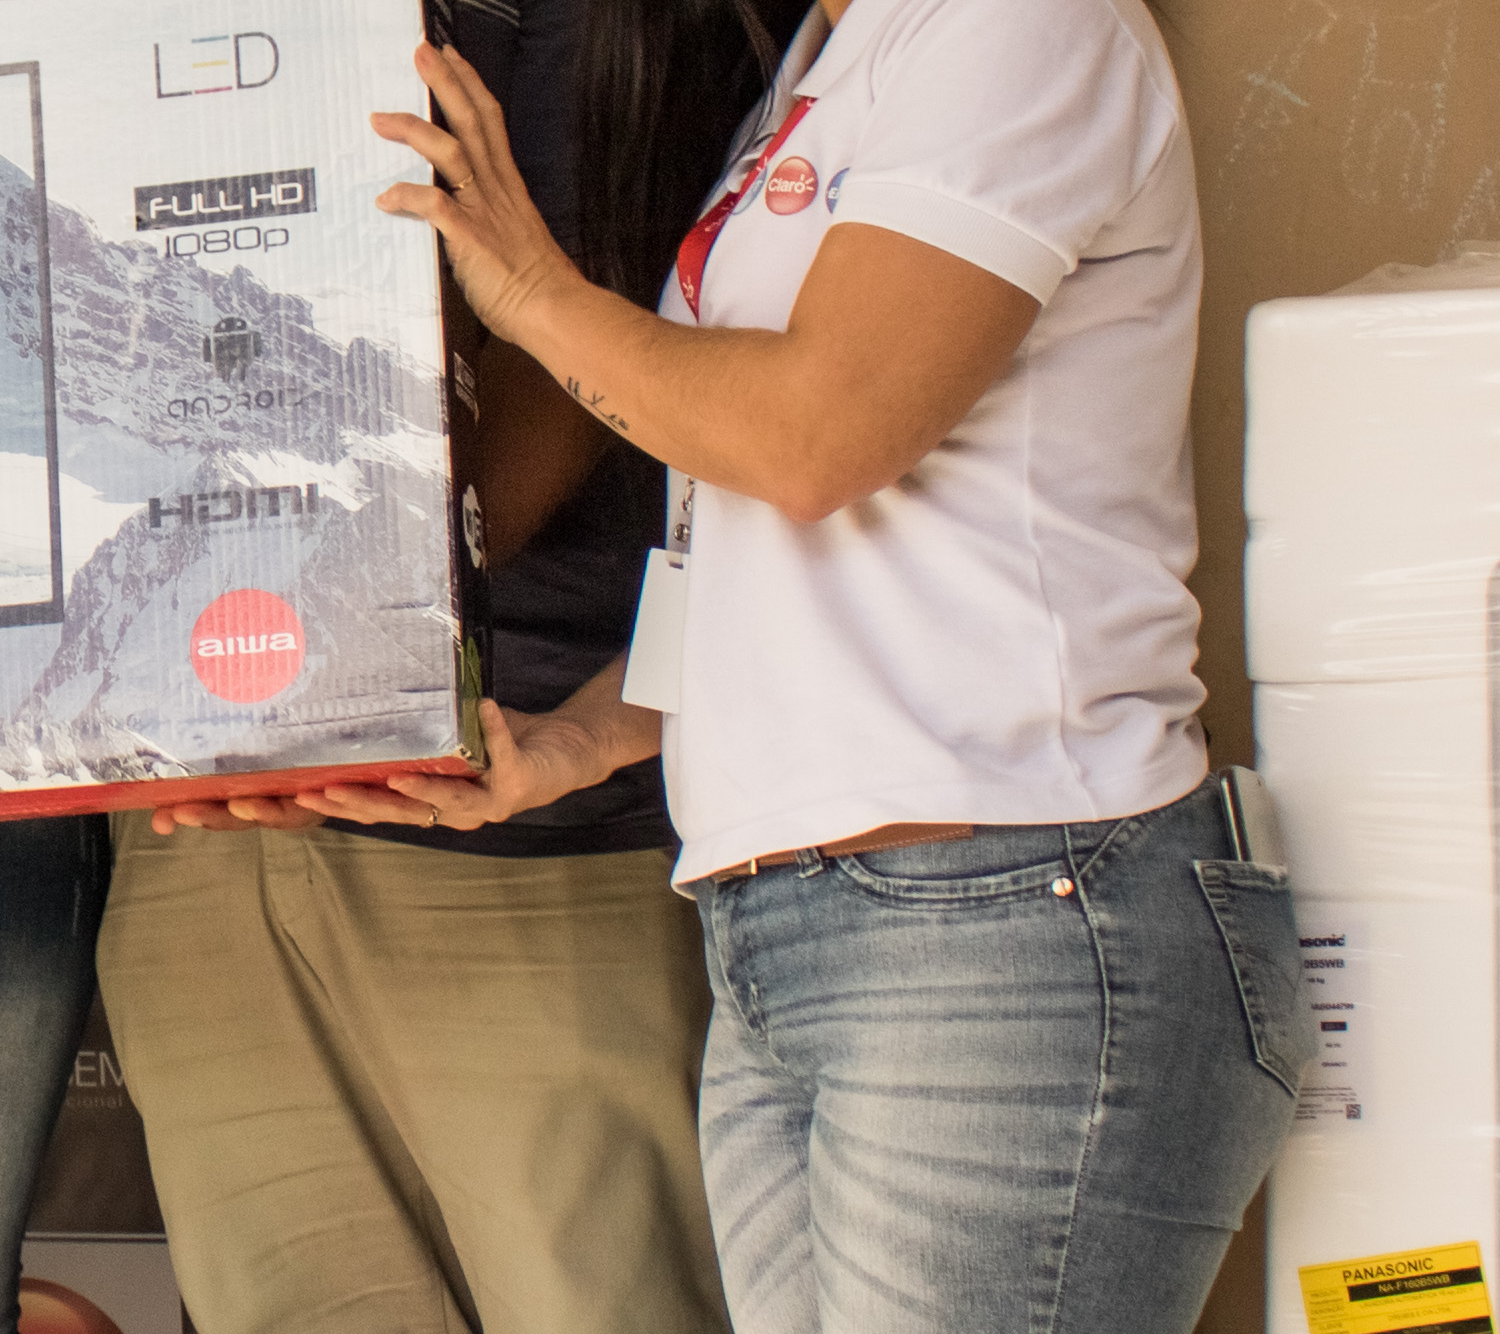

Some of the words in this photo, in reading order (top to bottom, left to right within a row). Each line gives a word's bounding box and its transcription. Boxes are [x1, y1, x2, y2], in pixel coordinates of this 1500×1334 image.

[154, 30, 281, 100] LED
[768, 176, 805, 194] Claro
[148, 187, 246, 220] FULL
[250, 181, 304, 208] HD
[164, 225, 291, 259] 1080p
[197, 631, 298, 658] aiwa
[1299, 933, 1346, 948] sonic
[1342, 1257, 1434, 1283] PANASONIC
